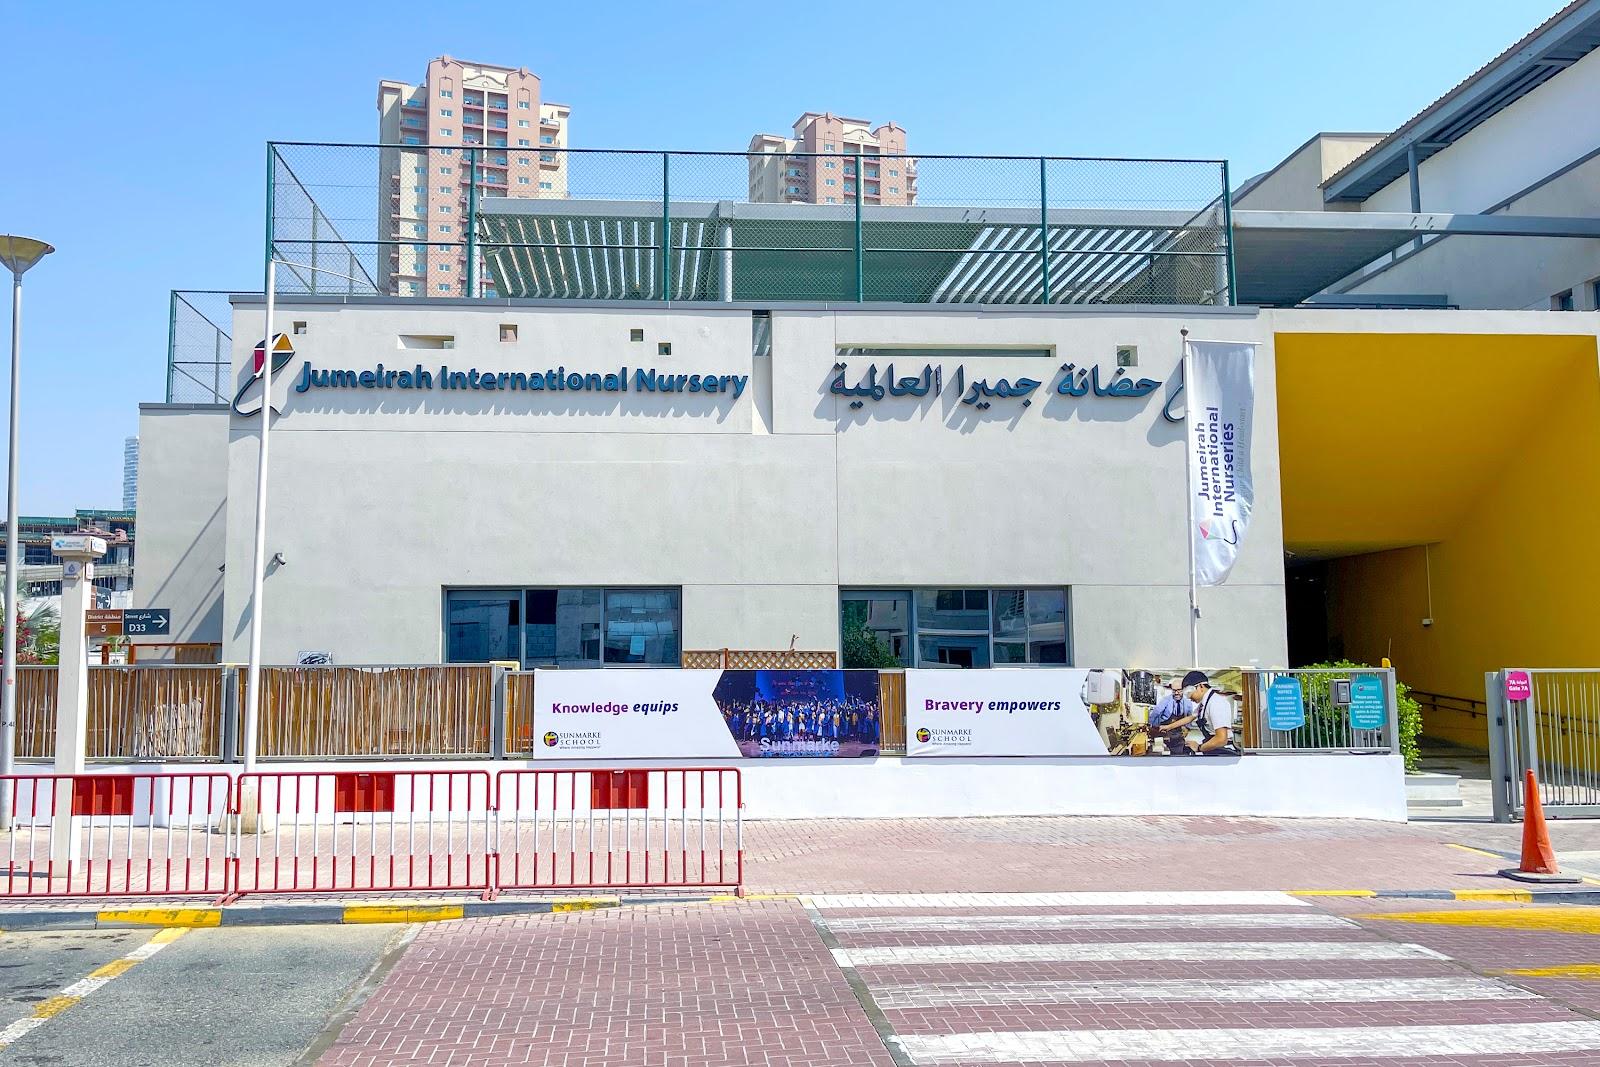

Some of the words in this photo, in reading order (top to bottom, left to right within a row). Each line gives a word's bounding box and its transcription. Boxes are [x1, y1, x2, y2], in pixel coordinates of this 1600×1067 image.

[296, 361, 432, 393] Jumeirah
[441, 365, 628, 392] International
[637, 368, 748, 400] Nursery
[829, 361, 942, 409] العالمية
[957, 363, 1042, 409] جميرا
[1057, 362, 1163, 398] حضانة
[1195, 422, 1210, 501] Jumeirah
[1206, 406, 1224, 517] International
[1220, 422, 1236, 502] Nurseries
[100, 624, 107, 633] 5
[129, 624, 146, 632] D33
[552, 701, 629, 715] Knowledge
[632, 700, 679, 715] equips
[925, 699, 984, 715] Bravery
[988, 699, 1061, 714] empowers
[760, 737, 840, 751] Sunmarke
